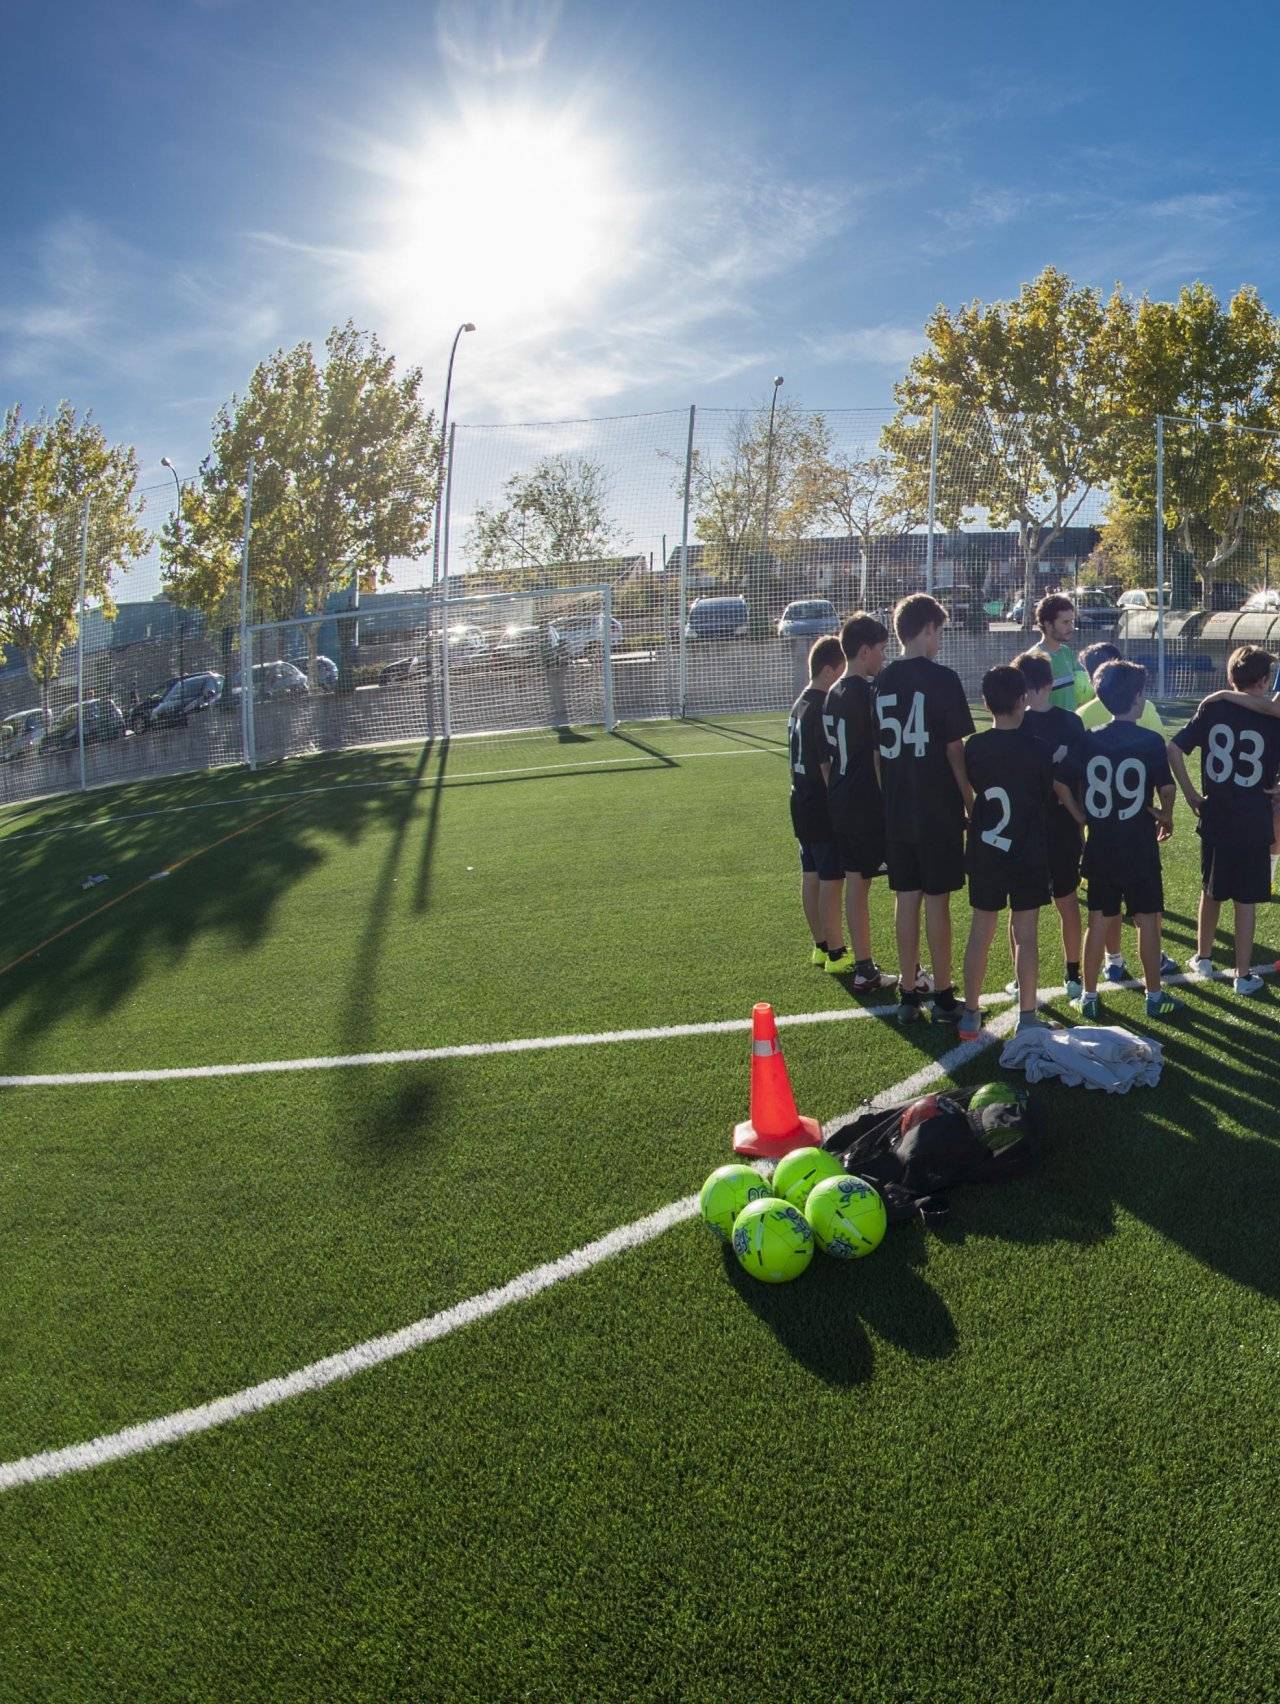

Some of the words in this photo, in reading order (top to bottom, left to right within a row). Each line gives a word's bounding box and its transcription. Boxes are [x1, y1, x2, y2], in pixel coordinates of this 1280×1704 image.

[876, 691, 930, 759] 54
[1205, 723, 1266, 788] 83
[981, 786, 1012, 852] 2
[1085, 755, 1147, 821] 89
